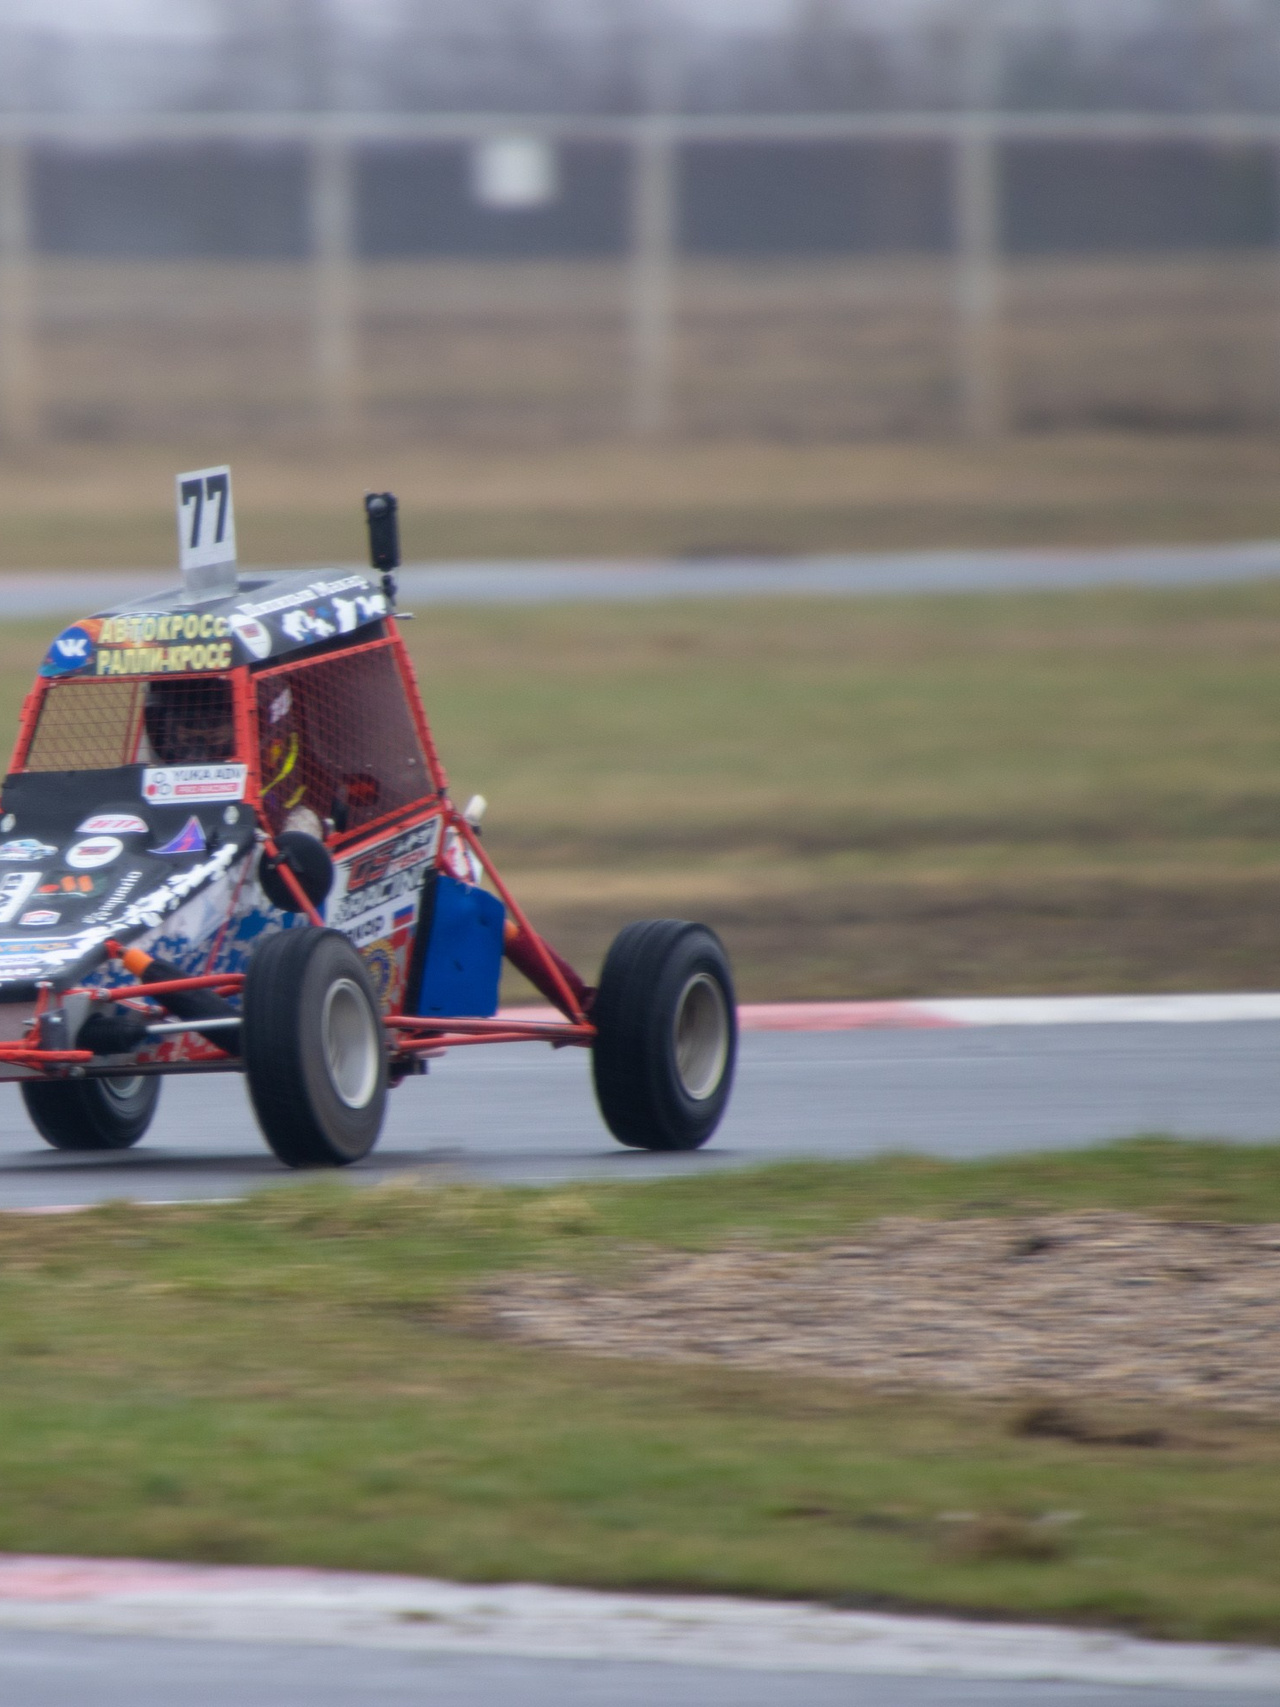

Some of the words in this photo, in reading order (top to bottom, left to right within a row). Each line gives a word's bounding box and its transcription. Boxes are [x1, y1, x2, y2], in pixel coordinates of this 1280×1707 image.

[180, 472, 229, 549] 77
[98, 612, 232, 645] АВТОКРОСС
[95, 642, 232, 675] РАЛЛИ-КРОСС
